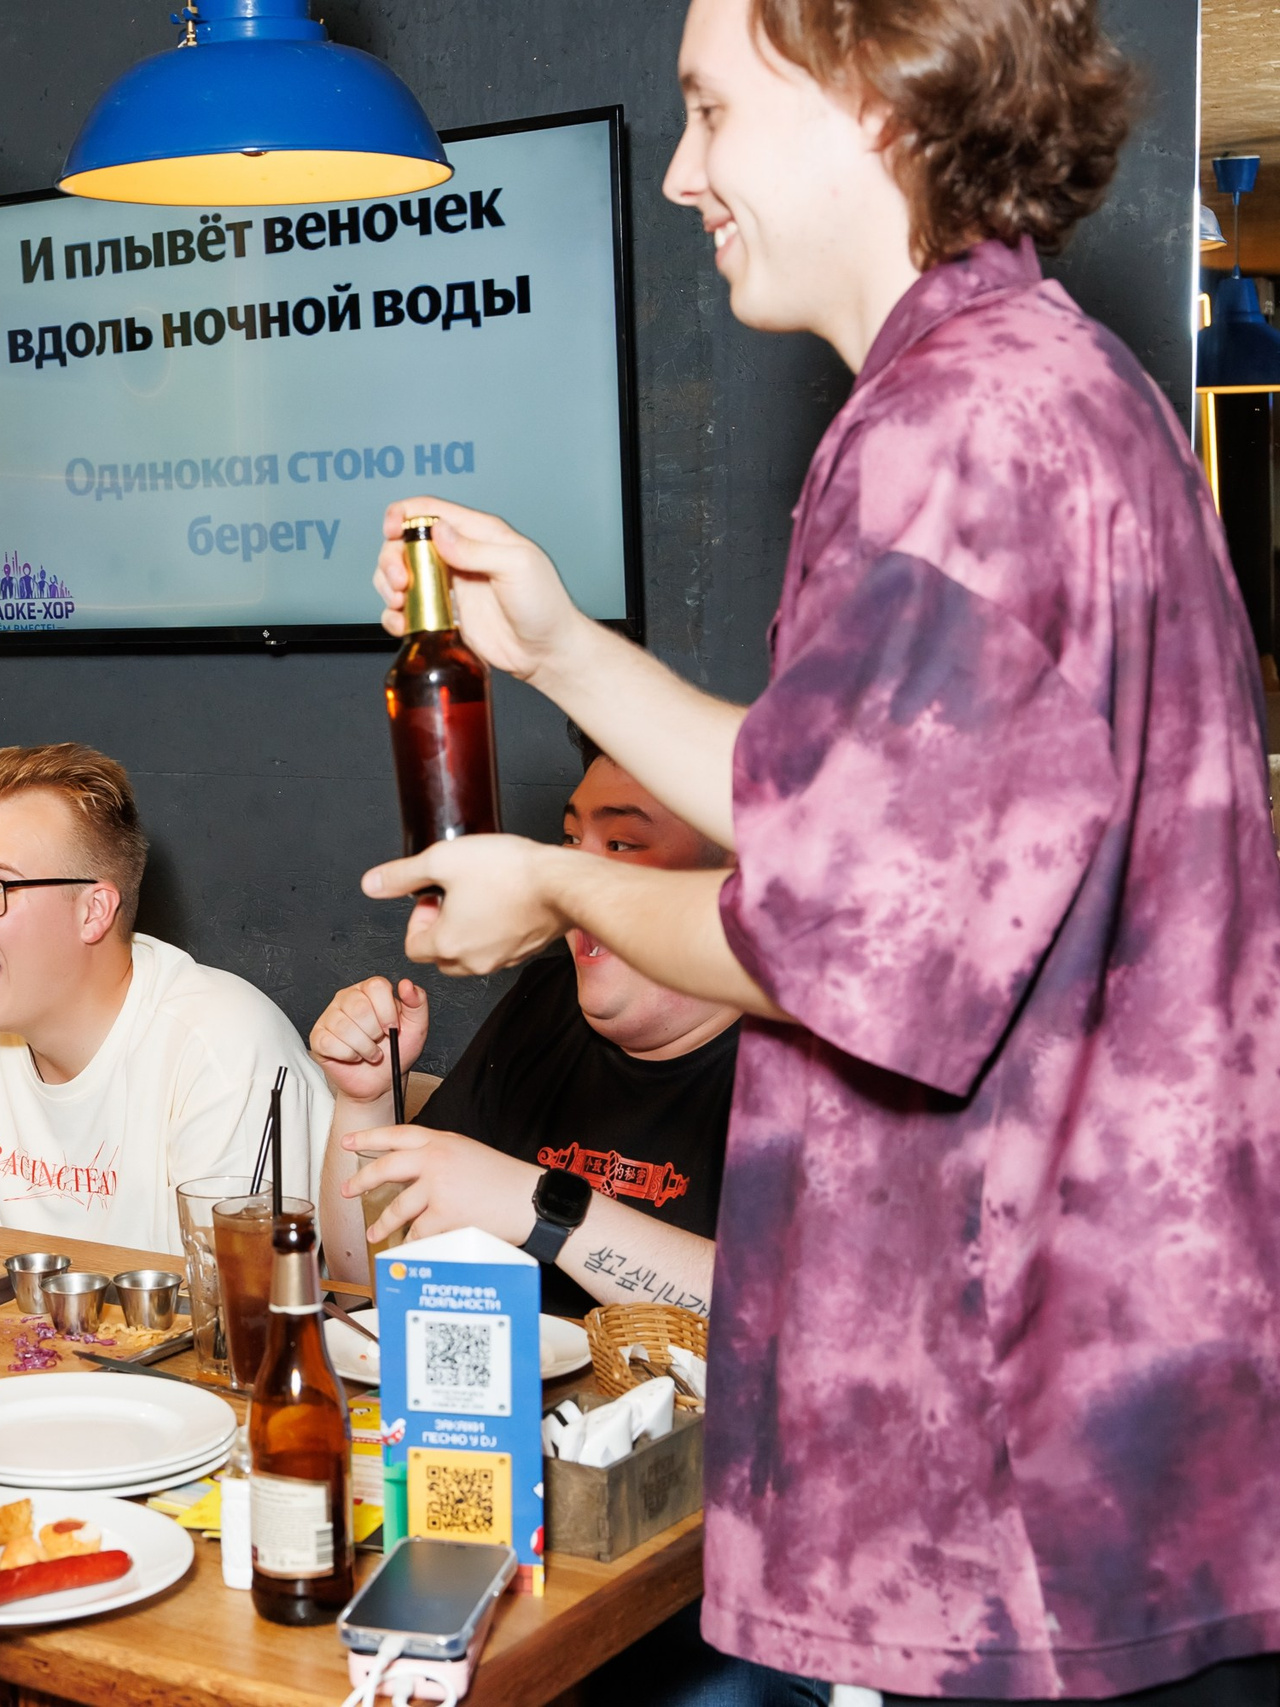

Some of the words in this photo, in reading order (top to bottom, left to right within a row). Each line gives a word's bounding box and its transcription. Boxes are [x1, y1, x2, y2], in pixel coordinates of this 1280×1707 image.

[20, 236, 55, 284] И
[64, 212, 254, 281] плывёт
[263, 187, 507, 256] веночек
[7, 316, 154, 370] вдоль
[162, 282, 362, 349] ночной
[372, 274, 532, 332] воды
[64, 453, 280, 501] Одинокая
[287, 444, 405, 483] стою
[414, 440, 476, 477] на
[187, 514, 342, 563] берегу
